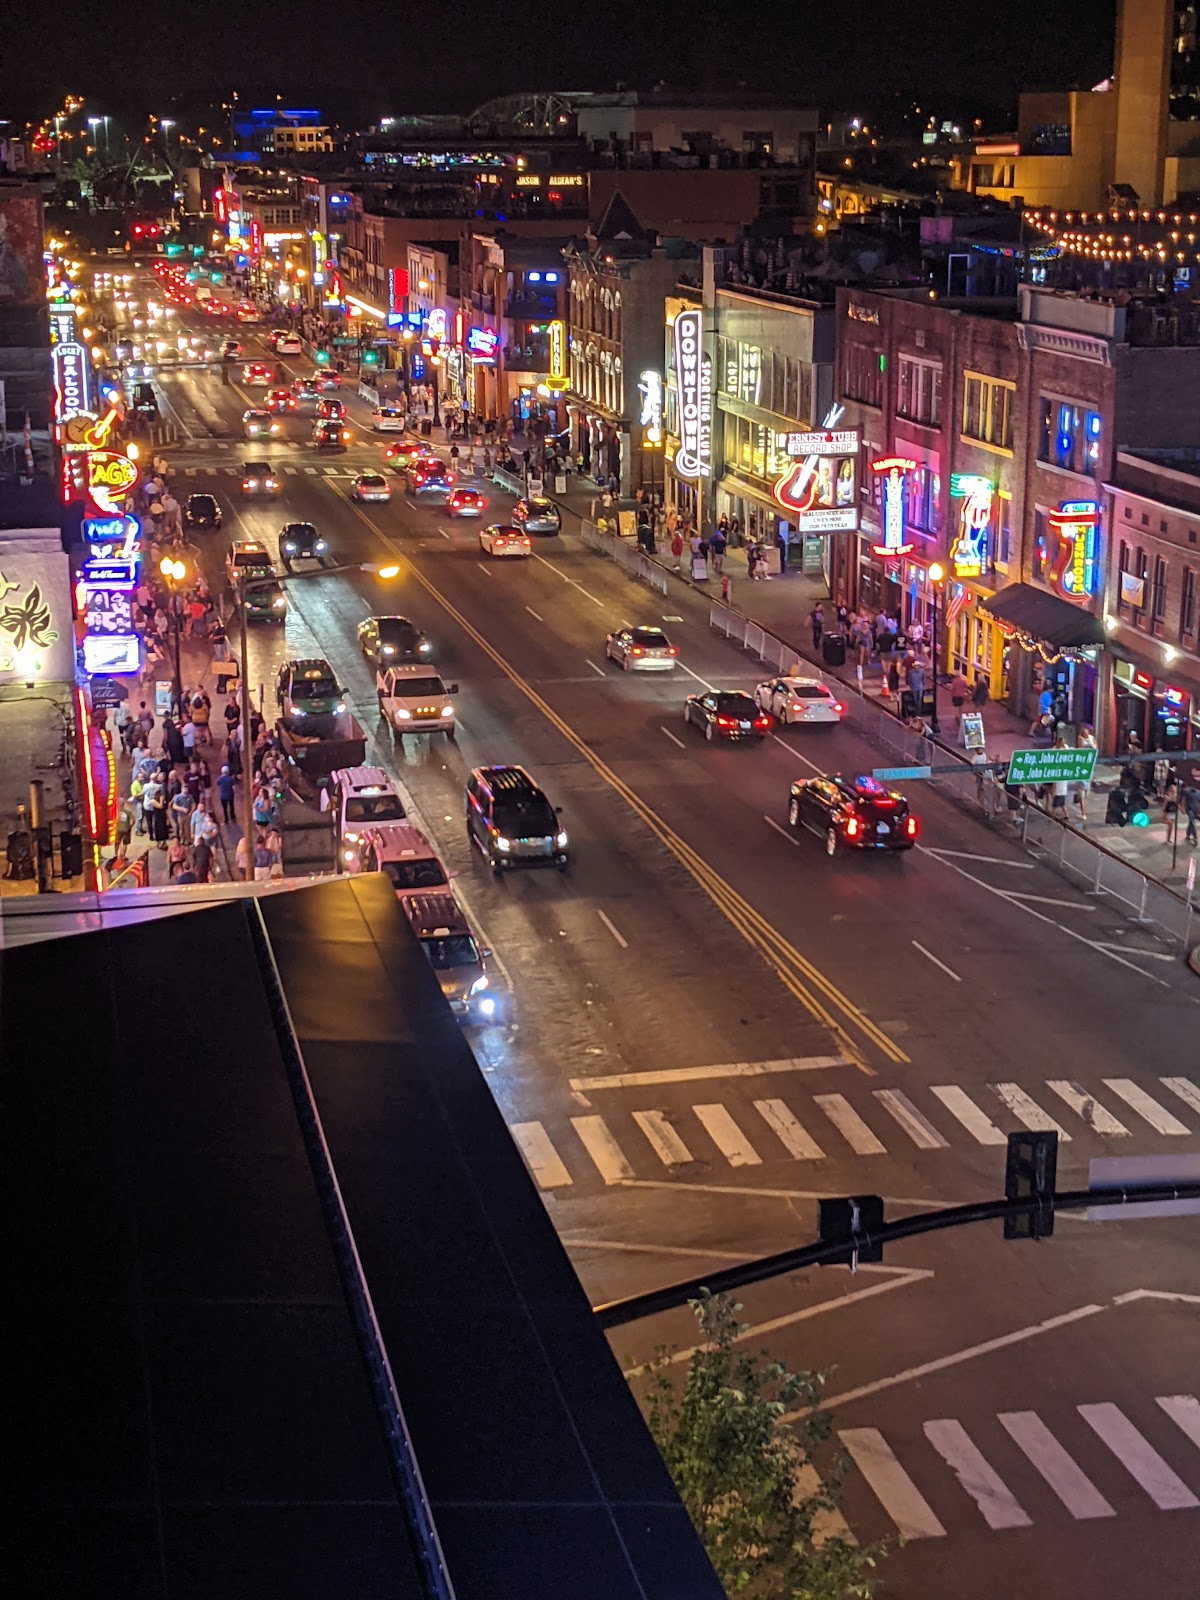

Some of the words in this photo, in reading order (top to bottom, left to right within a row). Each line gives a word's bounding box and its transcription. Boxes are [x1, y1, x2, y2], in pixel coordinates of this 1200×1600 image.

[516, 176, 539, 186] JASON
[549, 176, 583, 186] ALDEAN'S
[58, 348, 81, 356] LUCKY
[681, 320, 698, 451] DOWNTOWN
[700, 361, 711, 422] SPORTING
[700, 425, 711, 457] CLUB
[788, 432, 828, 443] ERNEST
[830, 431, 857, 442] TUBB
[793, 444, 827, 454] RECORD
[830, 443, 852, 453] SHOP
[872, 458, 917, 471] NASHVILLE
[1060, 645, 1078, 654] Pizza
[1081, 643, 1105, 653] Spirits
[1023, 752, 1038, 766] Rep.
[1039, 752, 1055, 764] John
[1055, 751, 1074, 764] Lewis
[1086, 752, 1094, 763] N
[1012, 767, 1025, 781] Rep.
[1026, 767, 1042, 779] John
[1043, 766, 1062, 778] Lewis
[1074, 765, 1081, 777] S
